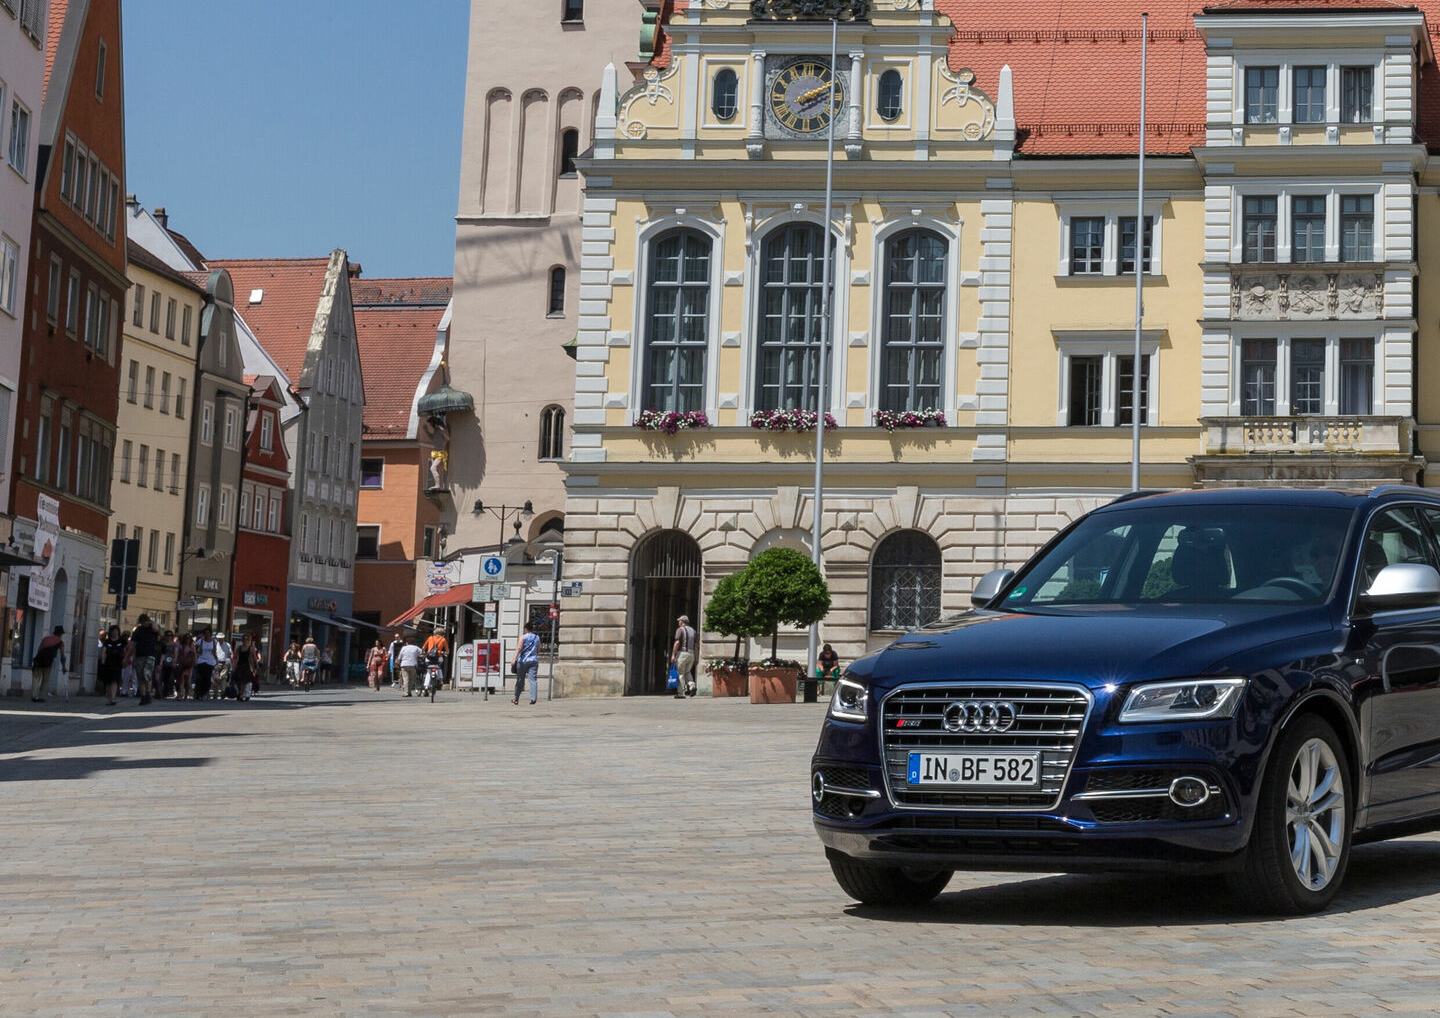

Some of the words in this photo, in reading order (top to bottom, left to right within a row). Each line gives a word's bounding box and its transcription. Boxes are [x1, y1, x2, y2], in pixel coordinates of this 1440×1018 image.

[1267, 465, 1337, 479] RATHAUS
[923, 757, 948, 781] IN
[962, 758, 989, 781] BF
[993, 758, 1034, 782] 582
